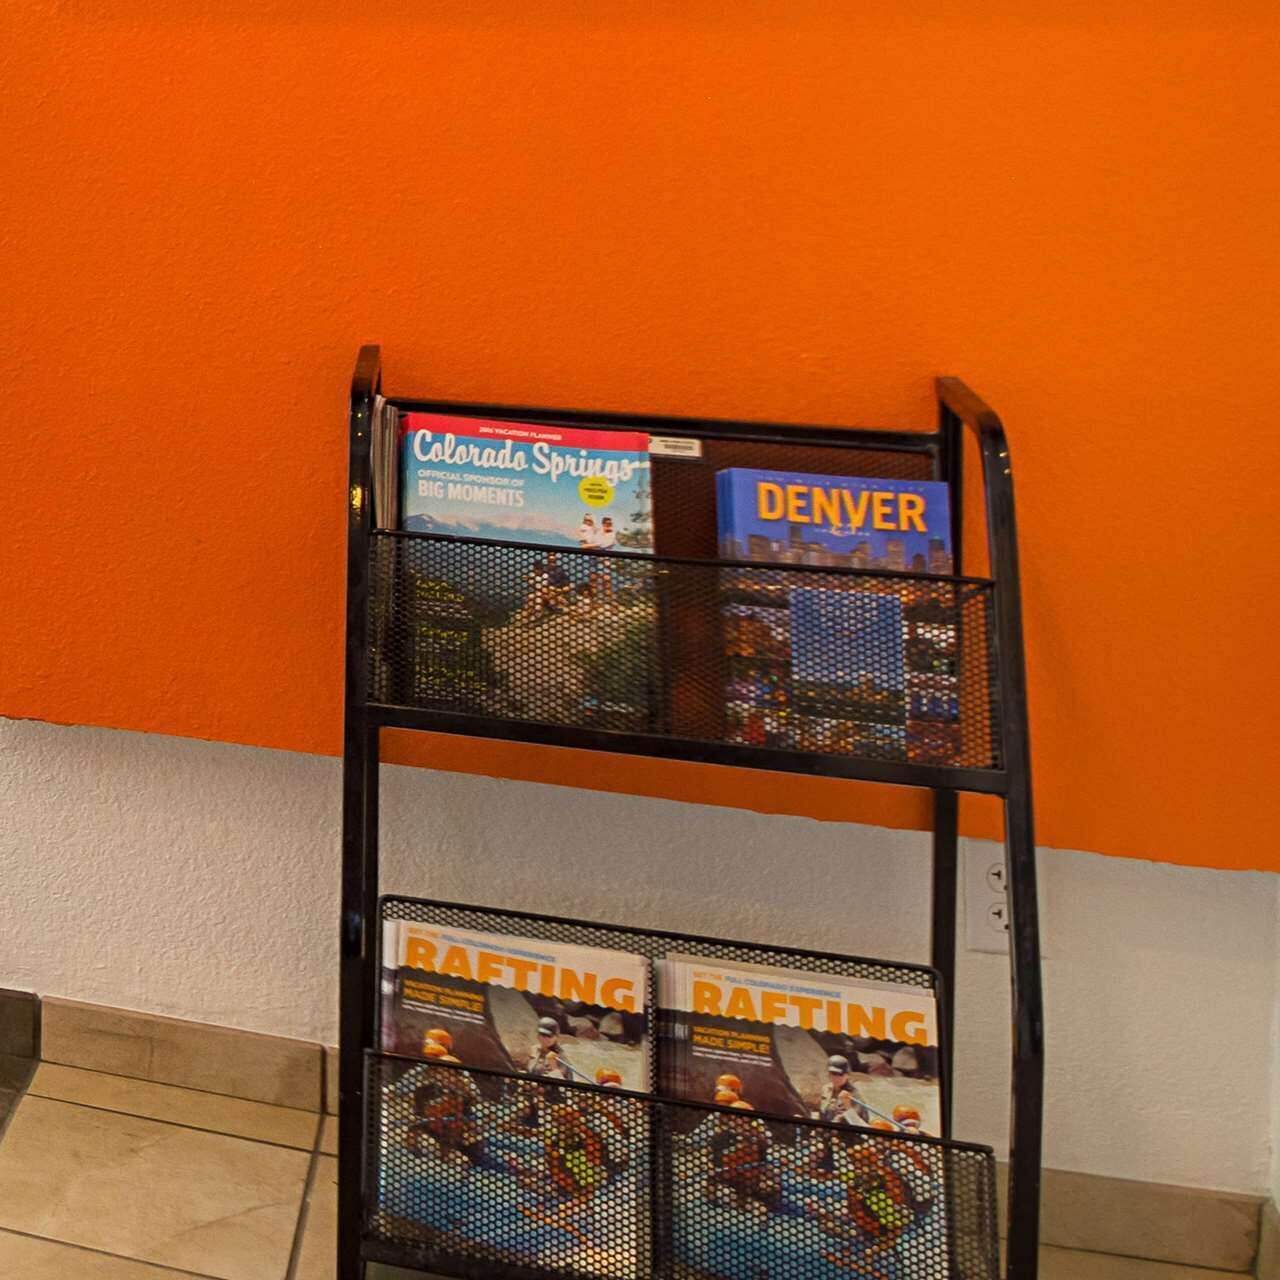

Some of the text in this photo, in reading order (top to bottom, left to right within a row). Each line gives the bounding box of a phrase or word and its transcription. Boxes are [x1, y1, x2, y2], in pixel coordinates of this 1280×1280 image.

[495, 428, 529, 438] VACATION
[530, 431, 563, 441] PLANNER
[413, 429, 650, 487] Colorado Springs
[418, 469, 525, 487] OFFICIAL SPONSOR OF
[418, 479, 525, 508] BIG MOMENTS
[757, 481, 928, 533] DENVER
[405, 936, 635, 1014] RAFTING
[404, 988, 436, 1004] MADE
[745, 978, 788, 992] COLORADO
[790, 983, 841, 998] EXPERIENCE
[692, 980, 928, 1047] RAFTING
[693, 1035, 723, 1048] MADE
